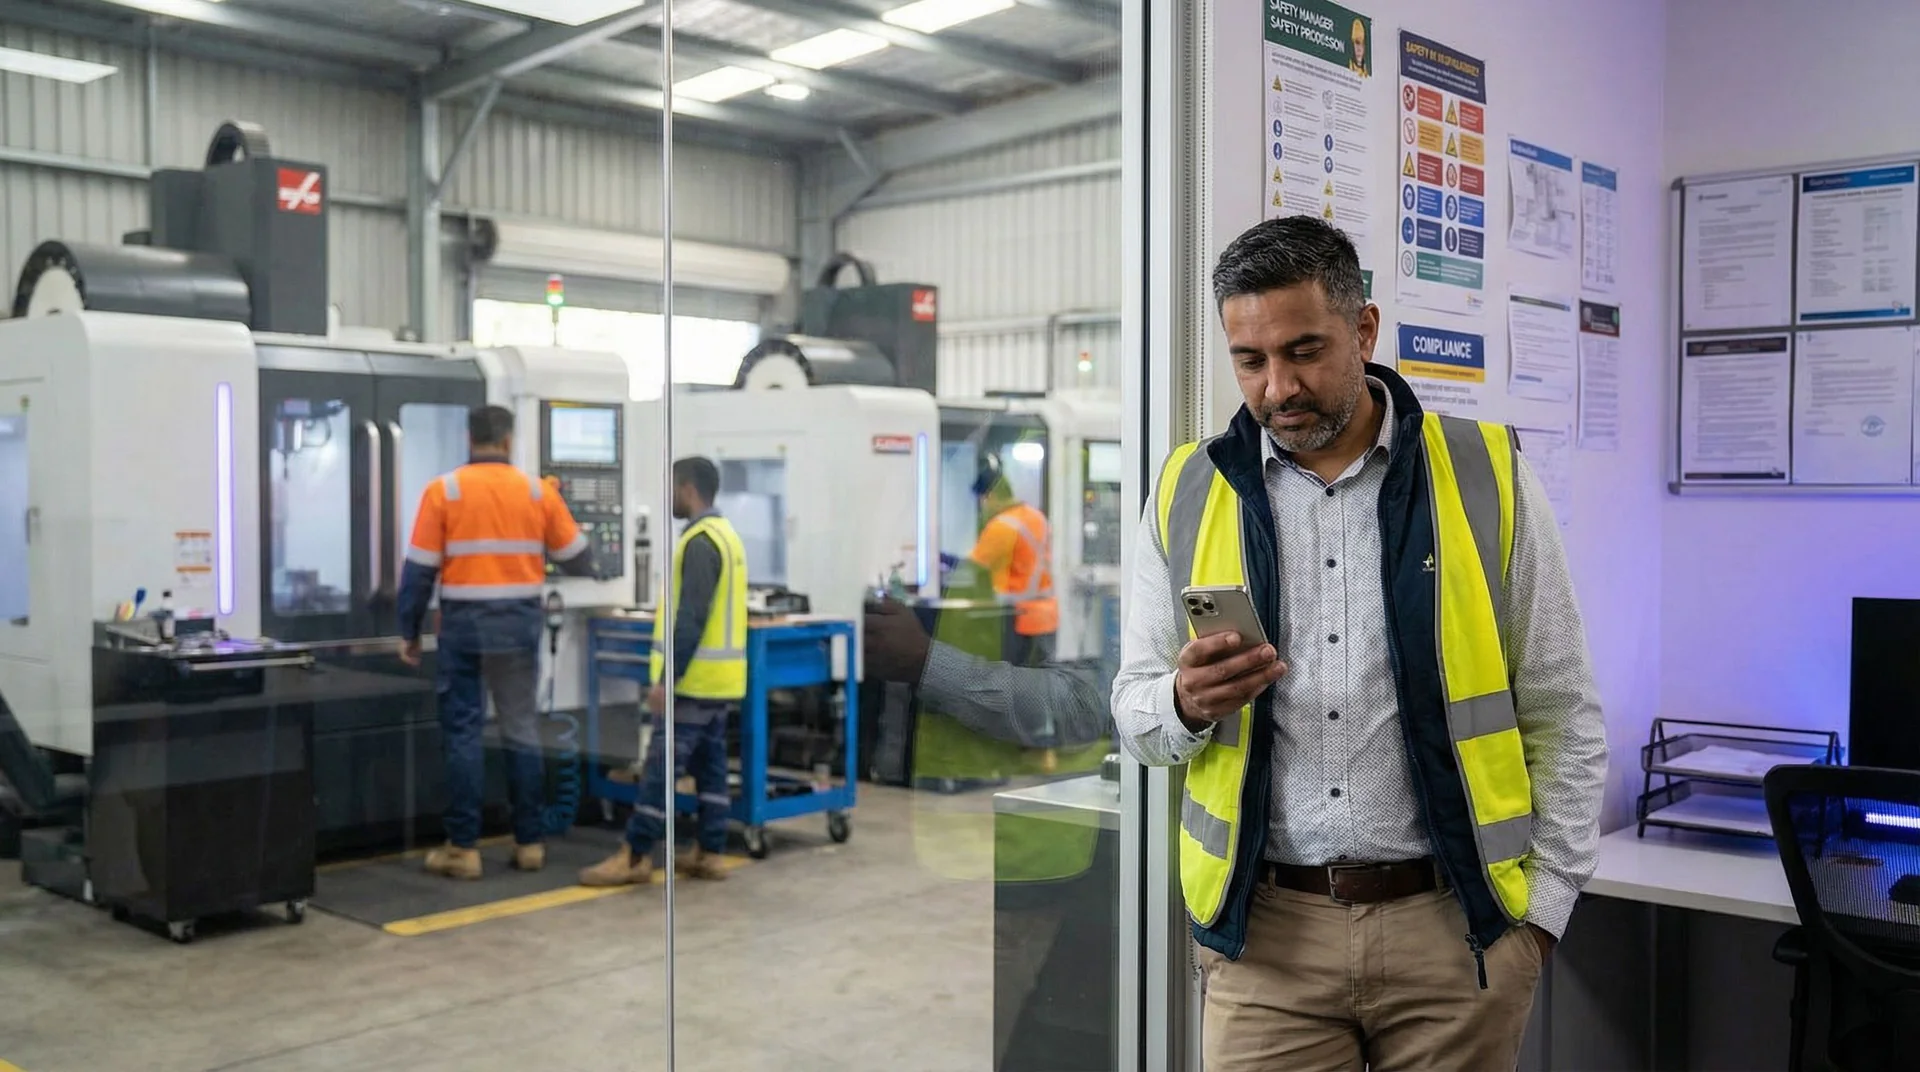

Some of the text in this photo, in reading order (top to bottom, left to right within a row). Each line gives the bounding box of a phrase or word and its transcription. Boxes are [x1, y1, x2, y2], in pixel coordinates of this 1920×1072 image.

[1269, 0, 1298, 18] SAFETY
[1270, 15, 1299, 37] SAFETY
[1412, 335, 1472, 359] COMPLIANCE
